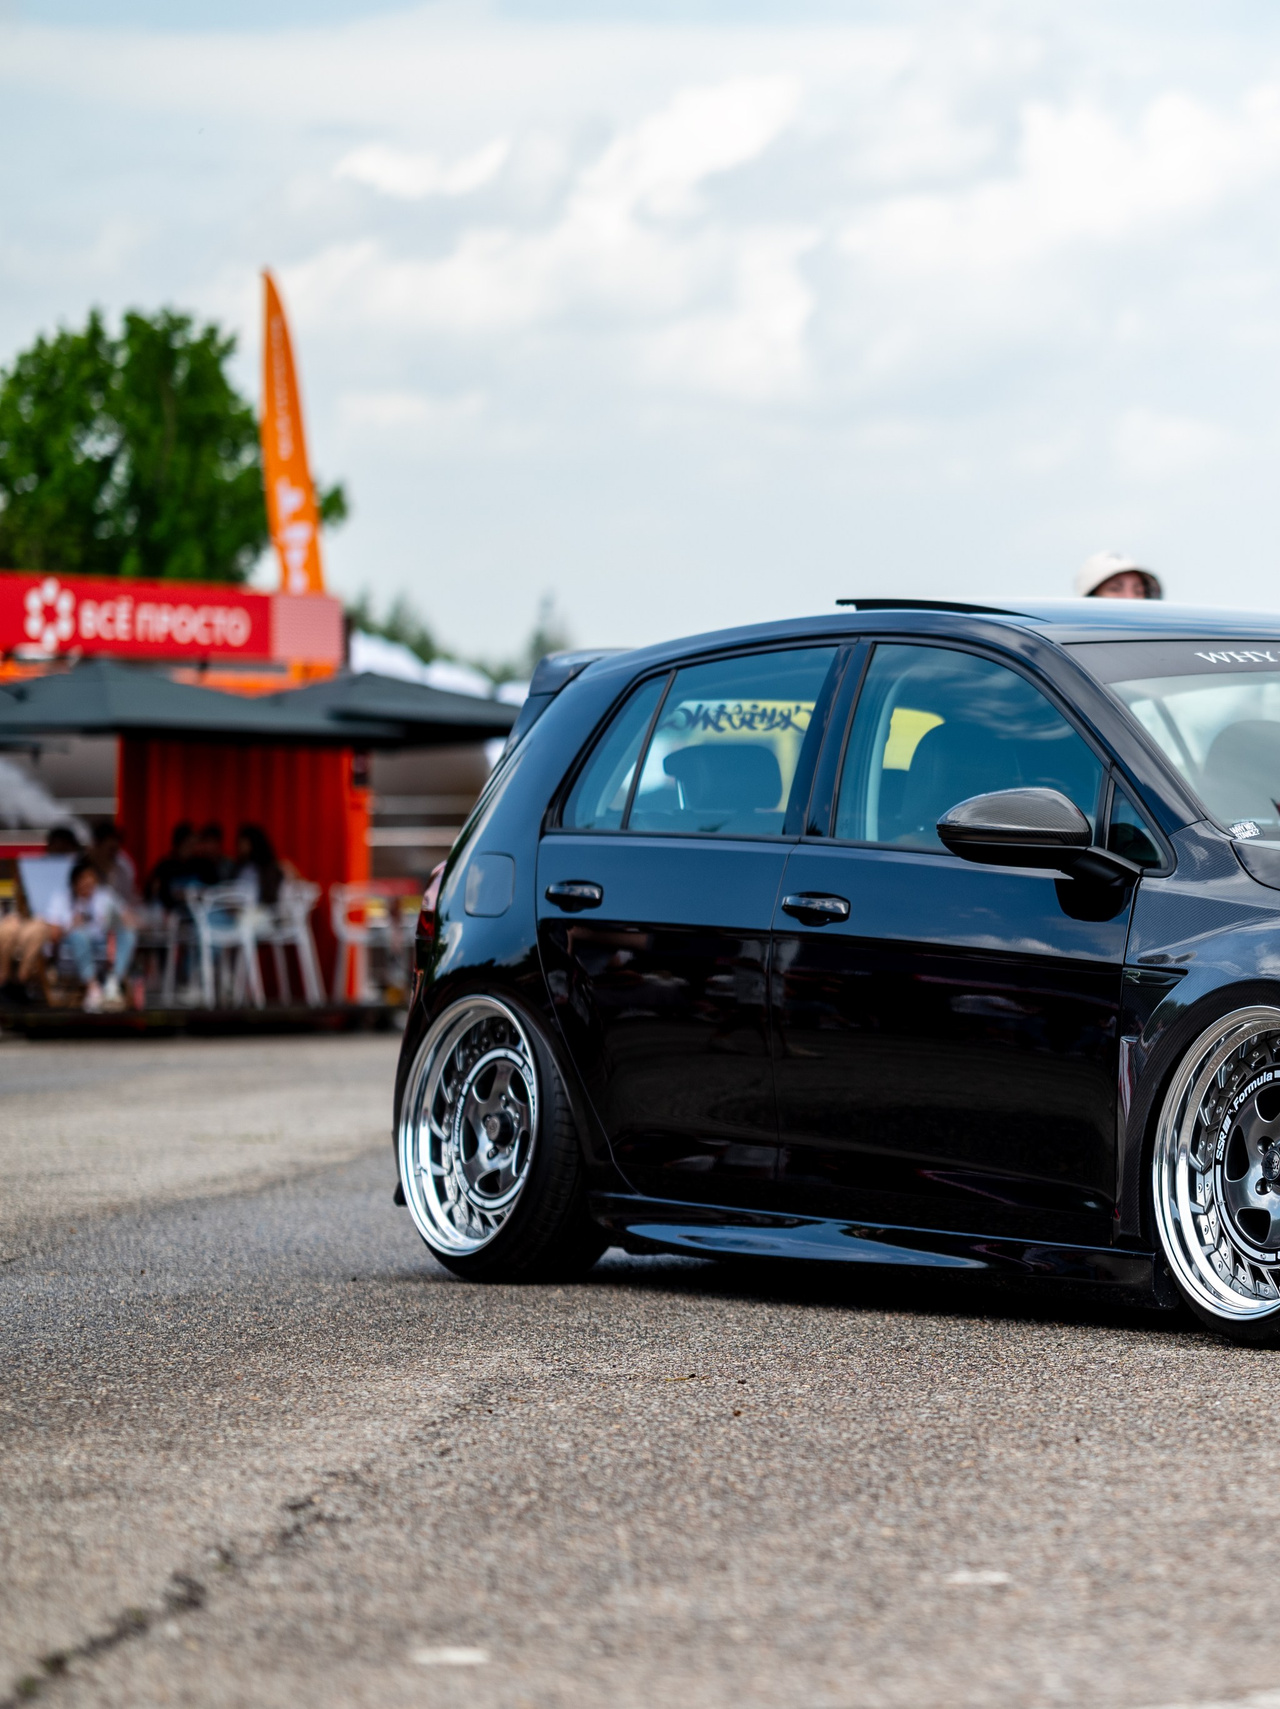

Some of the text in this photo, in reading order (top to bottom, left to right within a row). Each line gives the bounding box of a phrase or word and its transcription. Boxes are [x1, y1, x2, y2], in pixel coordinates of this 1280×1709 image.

[135, 602, 250, 647] ПРОСТО
[1195, 651, 1278, 664] WHY
[1215, 1071, 1274, 1161] SSR Formula
